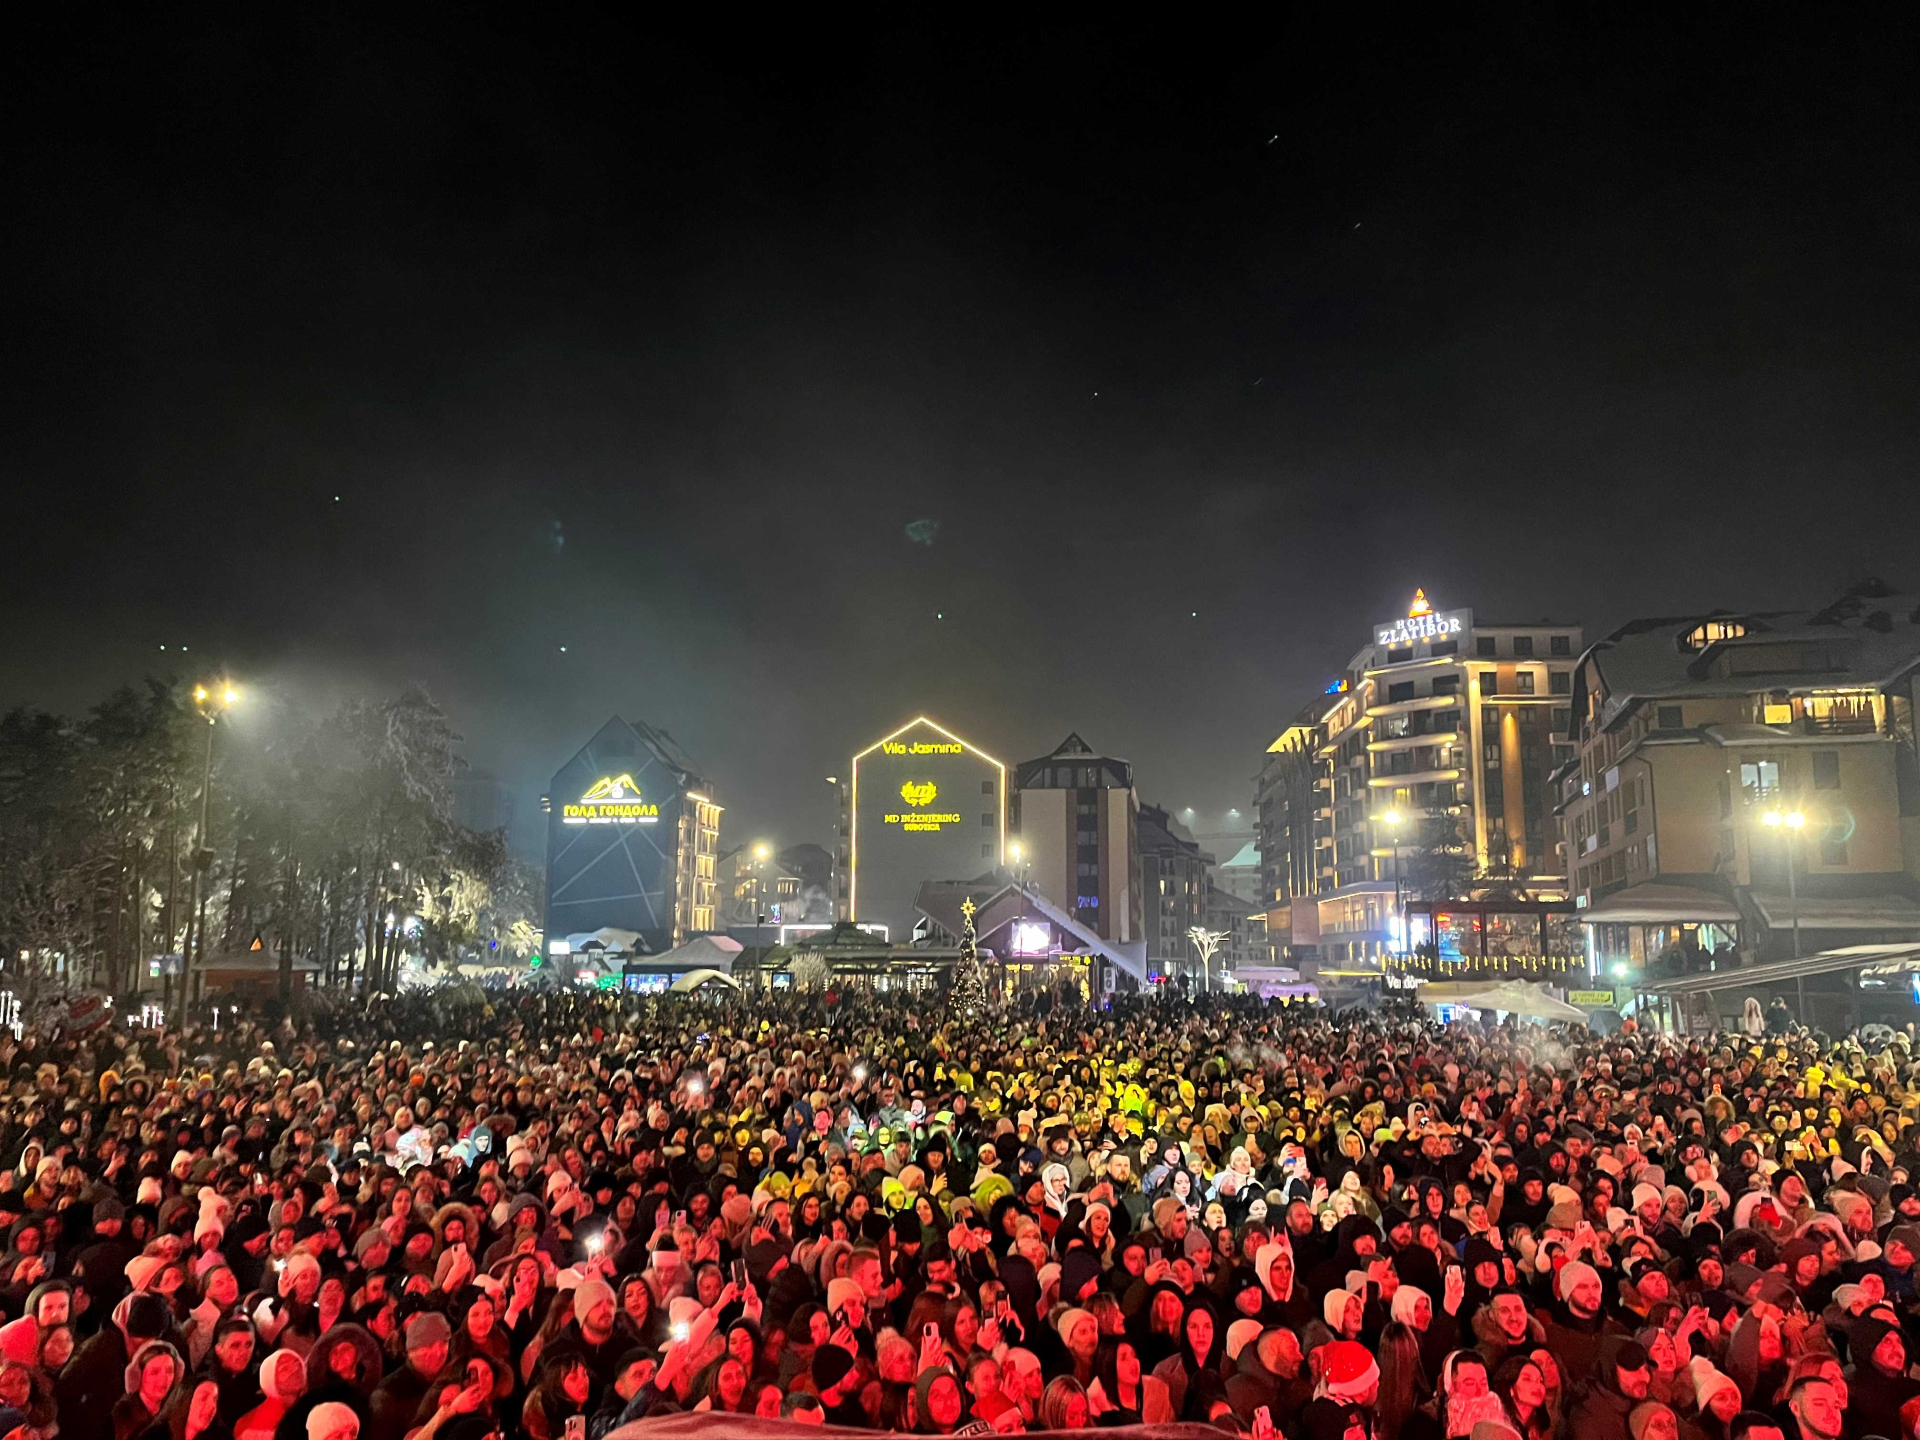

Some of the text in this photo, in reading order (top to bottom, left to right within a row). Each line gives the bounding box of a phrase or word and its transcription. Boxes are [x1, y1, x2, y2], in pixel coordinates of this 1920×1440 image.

[1396, 612, 1443, 629] HOTEL
[1379, 618, 1461, 645] ZLATIBOR
[883, 742, 962, 754] Vila Jasmina
[564, 805, 658, 818] ГОЛД ГОНДОЛА
[884, 814, 899, 823] MD
